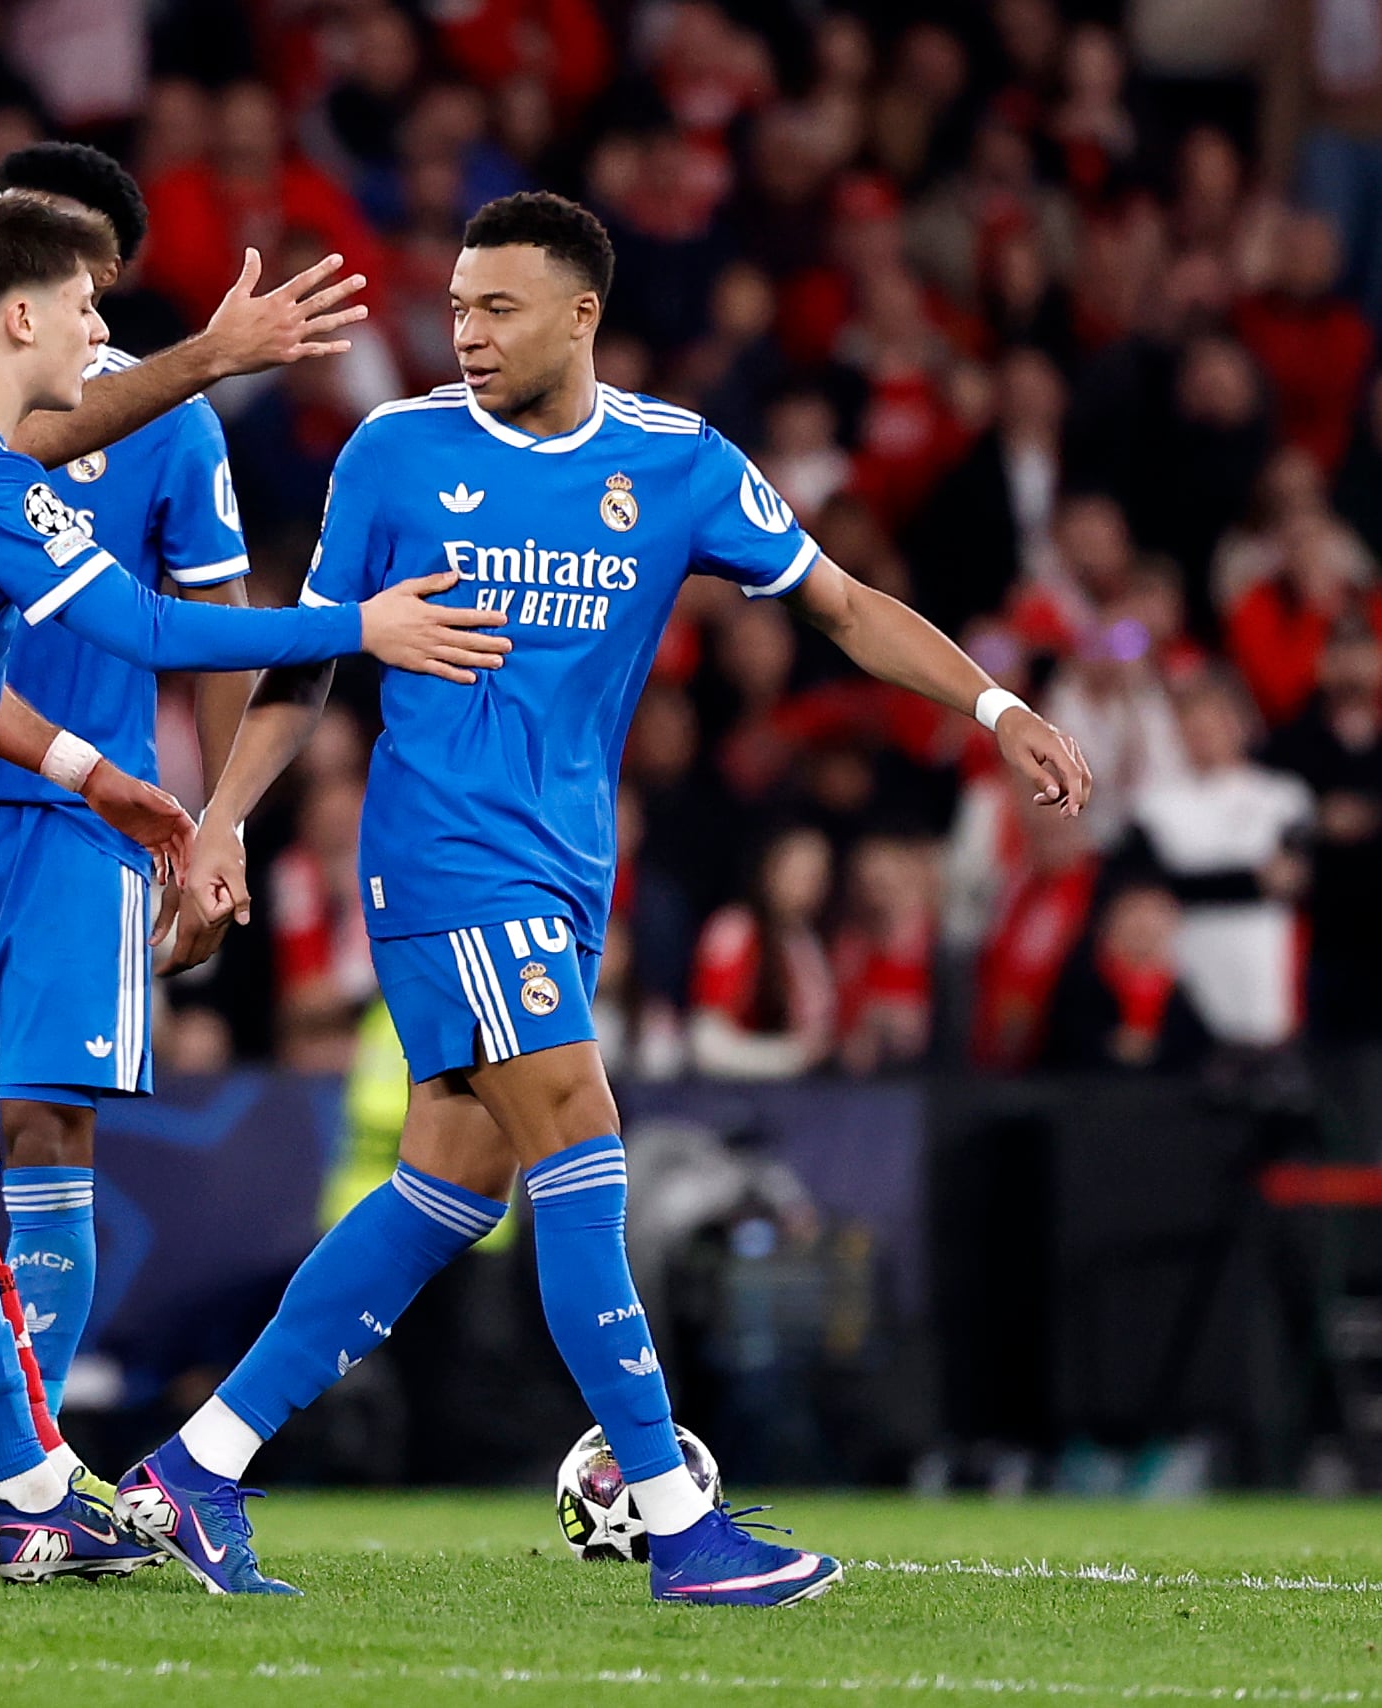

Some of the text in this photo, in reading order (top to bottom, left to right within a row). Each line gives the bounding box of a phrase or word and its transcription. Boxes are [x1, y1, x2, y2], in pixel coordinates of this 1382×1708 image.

[442, 538, 638, 591] Emirates
[519, 590, 609, 630] BETTER
[10, 1251, 75, 1273] RMCF
[359, 1310, 392, 1338] RM
